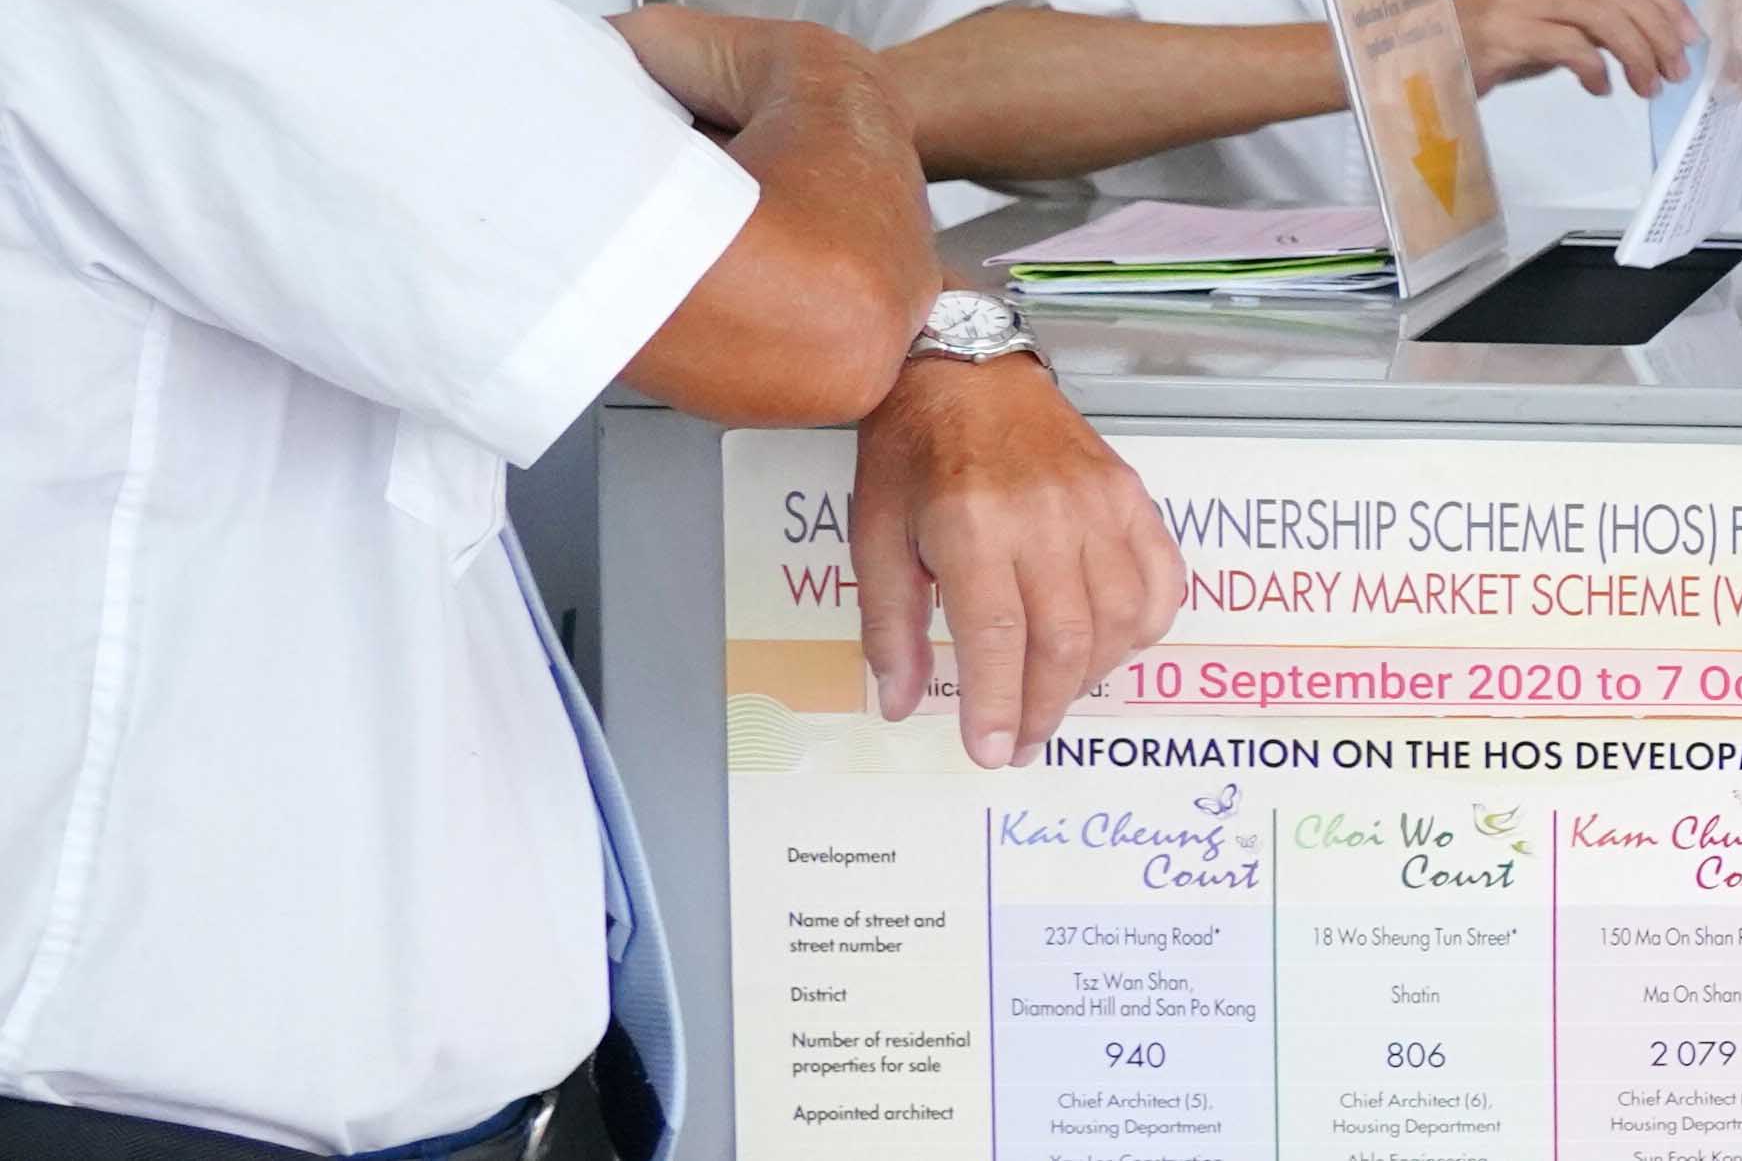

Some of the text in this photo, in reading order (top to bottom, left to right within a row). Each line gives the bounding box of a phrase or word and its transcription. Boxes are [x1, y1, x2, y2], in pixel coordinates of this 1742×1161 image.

[1151, 494, 1397, 552] WNERSHIP
[1407, 499, 1585, 557] SCHEME
[1597, 500, 1719, 566] (HOS)
[1178, 569, 1343, 615] NDARY
[1352, 571, 1520, 618] MARKET
[1530, 573, 1701, 619] SCHEME
[1126, 660, 1184, 700] 10
[1199, 659, 1453, 709] September
[1467, 663, 1583, 701] 2020
[1596, 665, 1643, 702] to
[1656, 665, 1683, 701] 7
[1044, 737, 1321, 769] INFORMATION
[1331, 737, 1395, 769] ON
[1404, 739, 1471, 770] THE
[1483, 739, 1564, 771] HOS
[999, 809, 1226, 862] Kai Cheung
[1294, 812, 1454, 850] Choi Wo
[1571, 813, 1659, 849] Kam
[787, 845, 897, 869] Development
[1143, 852, 1260, 890] Court
[1401, 853, 1515, 890] Court
[788, 910, 946, 929] Name of street and
[789, 935, 904, 954] street number
[1044, 926, 1078, 946] 237
[1081, 925, 1120, 946] Choi
[1124, 926, 1168, 952] Hung
[1313, 926, 1334, 947] 18
[1337, 927, 1368, 947] Wo
[1371, 925, 1431, 953] Sheung
[1434, 927, 1463, 947] Tun
[1600, 926, 1632, 947] 150
[1634, 928, 1662, 947] Ma
[1664, 926, 1691, 947] On
[1694, 925, 1734, 947] Shan
[1072, 970, 1194, 994] Tsz Wan Shan,
[1391, 983, 1441, 1005] Shatin
[1643, 983, 1742, 1004] Ma On Shan
[790, 986, 847, 1003] District
[1010, 997, 1257, 1023] Diamond Hill and San Po Kong
[791, 1030, 971, 1049] Number of residential
[791, 1055, 942, 1078] properties for sale
[1105, 1041, 1166, 1069] 940
[1386, 1041, 1446, 1069] 806
[1056, 1091, 1104, 1110] Chief
[1106, 1091, 1182, 1109] Architect
[1339, 1091, 1385, 1109] Chief
[1387, 1091, 1461, 1109] Architect
[1617, 1089, 1662, 1107] Chief
[1664, 1089, 1737, 1107] Architect
[792, 1102, 955, 1126] Appointed architect
[1050, 1119, 1223, 1140] Housing Department
[1332, 1118, 1501, 1139] Housing Department
[1610, 1117, 1678, 1136] Housing
